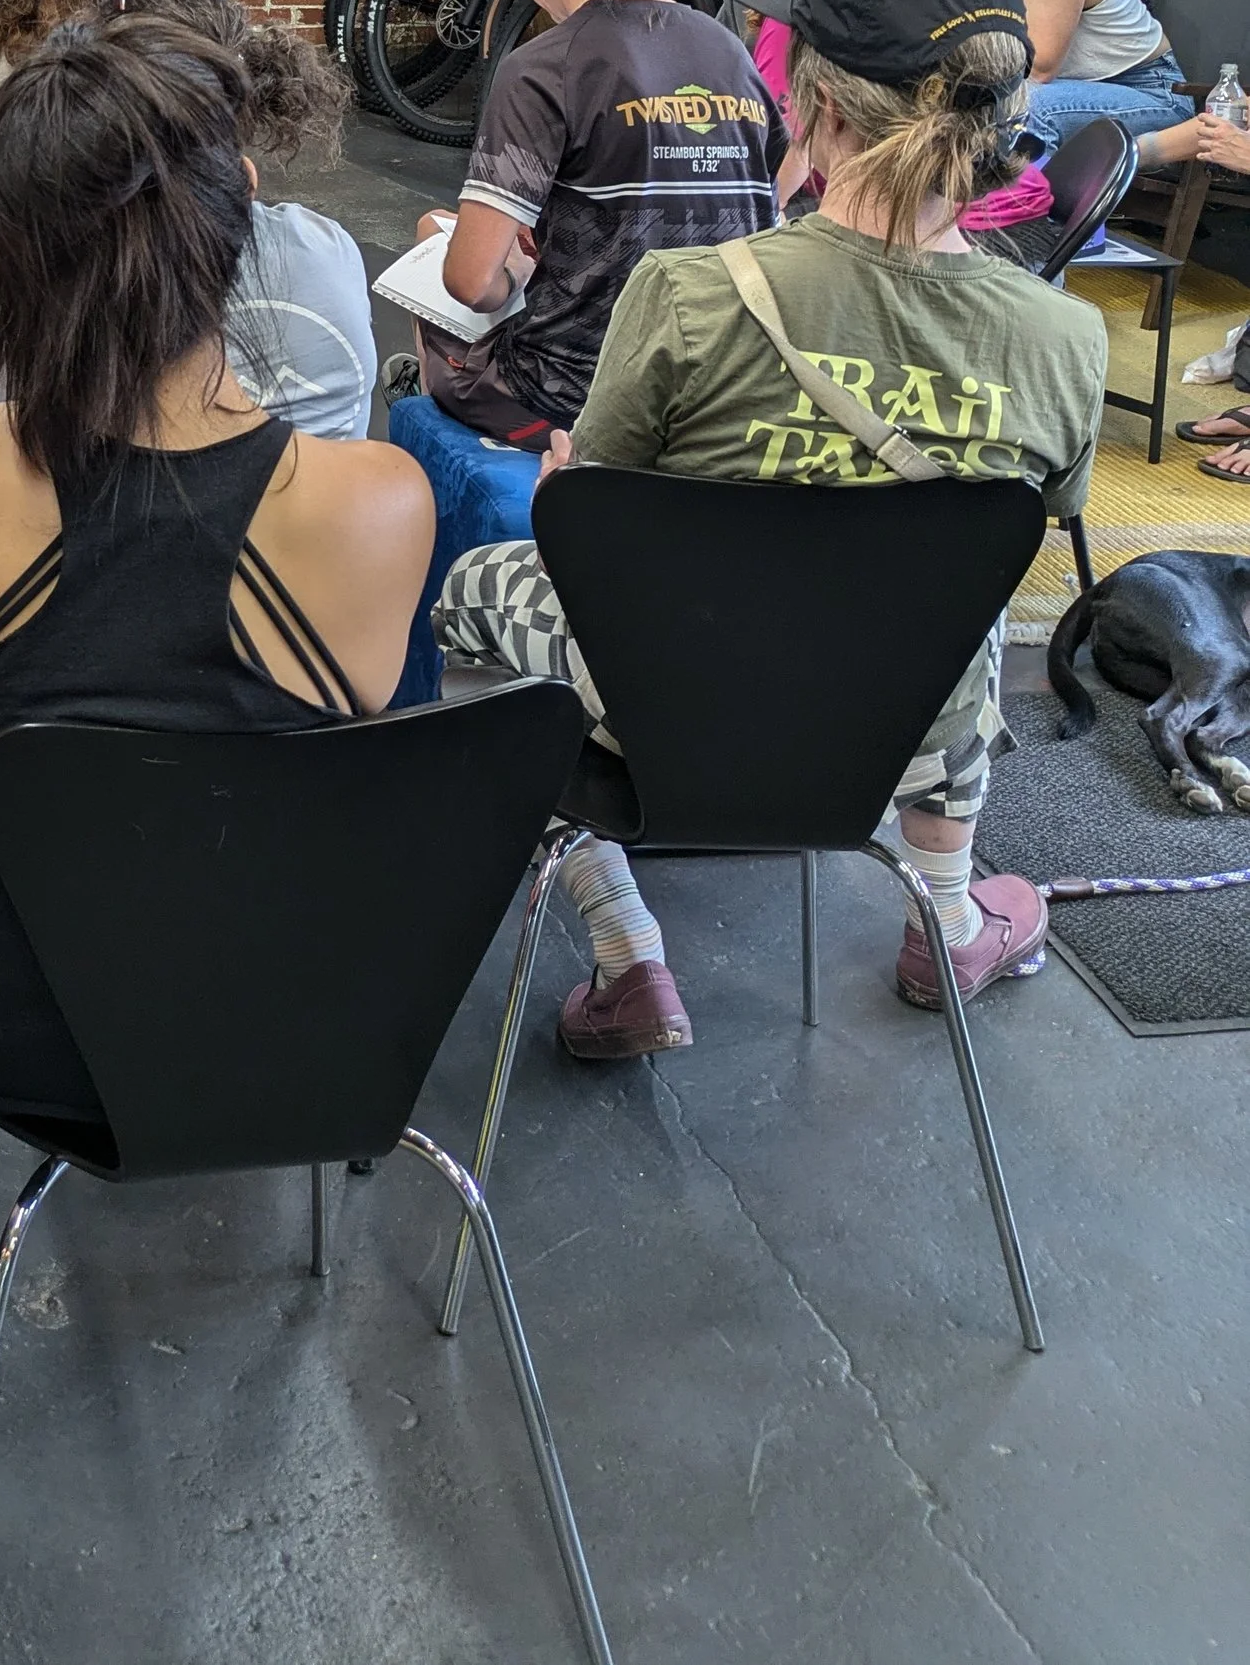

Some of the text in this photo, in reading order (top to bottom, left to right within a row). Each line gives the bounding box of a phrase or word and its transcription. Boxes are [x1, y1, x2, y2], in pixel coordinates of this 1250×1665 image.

[336, 15, 347, 63] MAXXIS
[615, 95, 711, 127] TWISTED
[709, 94, 767, 128] TRAILS
[652, 145, 705, 160] STEAMBOAT
[692, 160, 721, 174] 6,732'
